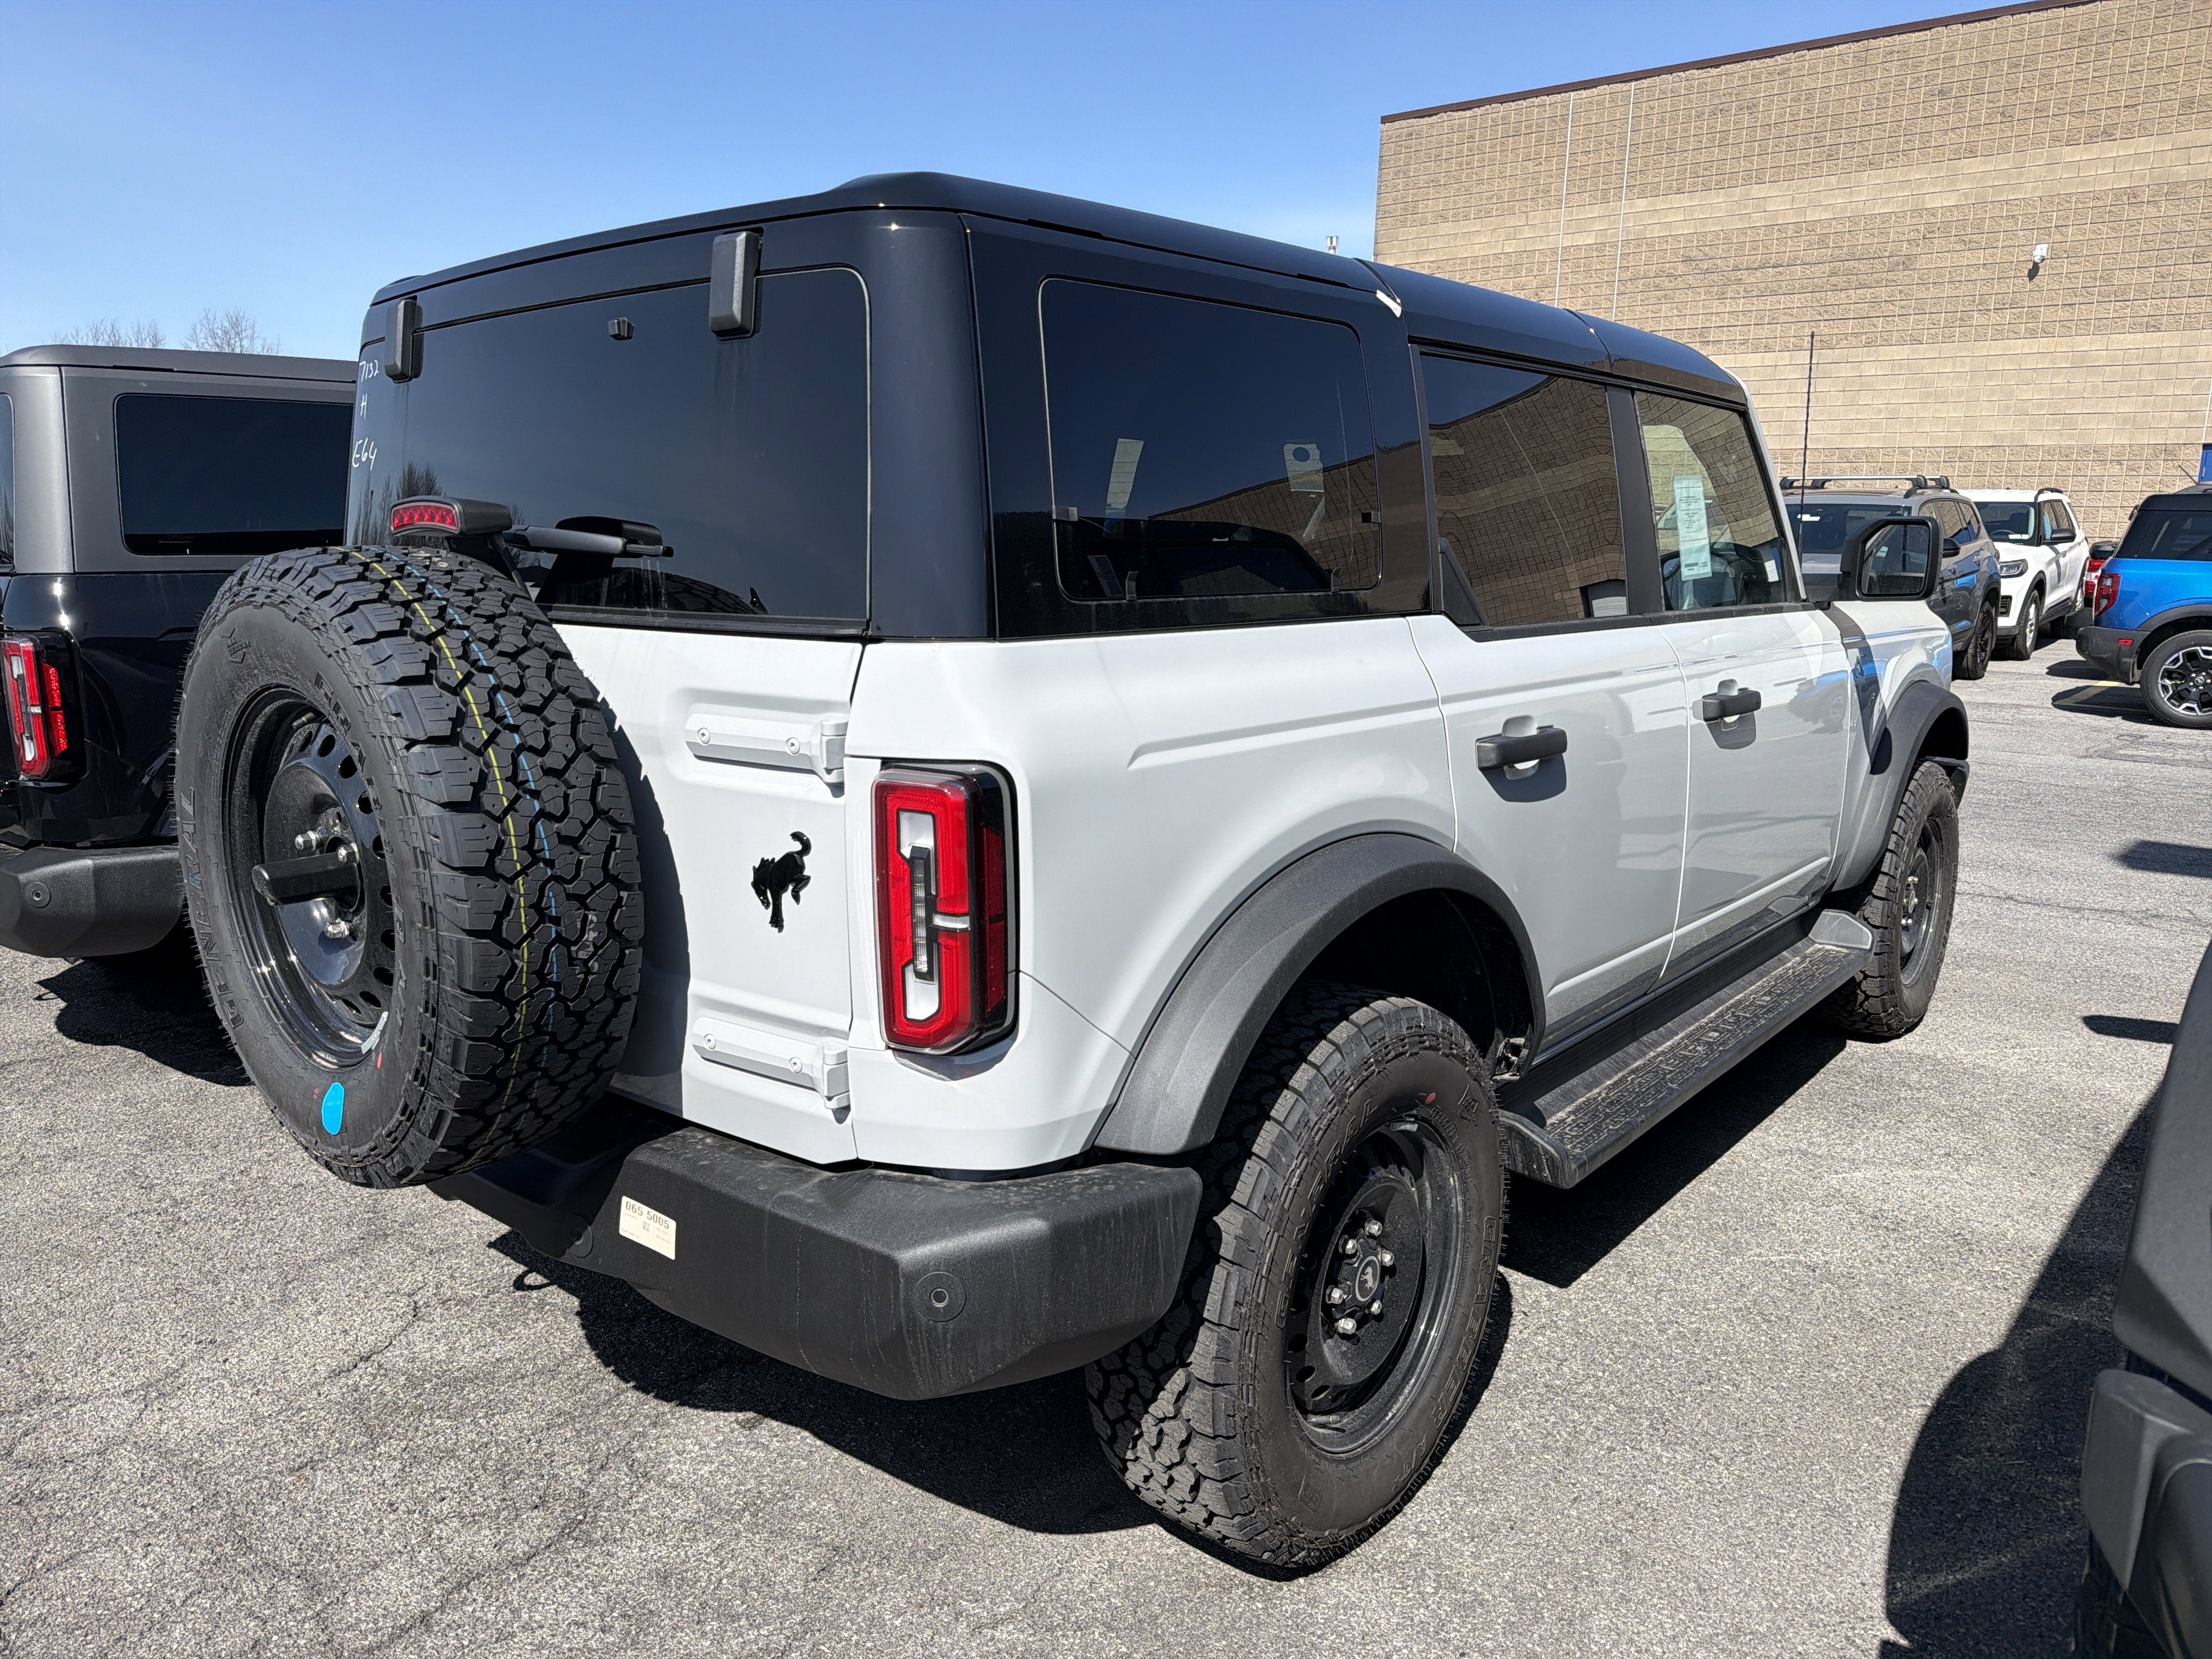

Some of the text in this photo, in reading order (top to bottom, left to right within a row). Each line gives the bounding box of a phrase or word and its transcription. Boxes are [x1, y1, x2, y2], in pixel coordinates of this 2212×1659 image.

[352, 437, 377, 471] E64
[360, 393, 368, 420] H
[180, 786, 245, 1029] GENERAL
[625, 1200, 643, 1216] 065
[647, 1211, 669, 1230] 5005
[1274, 1098, 1379, 1329] GENERAL
[1431, 1214, 1497, 1431] GRABBER
